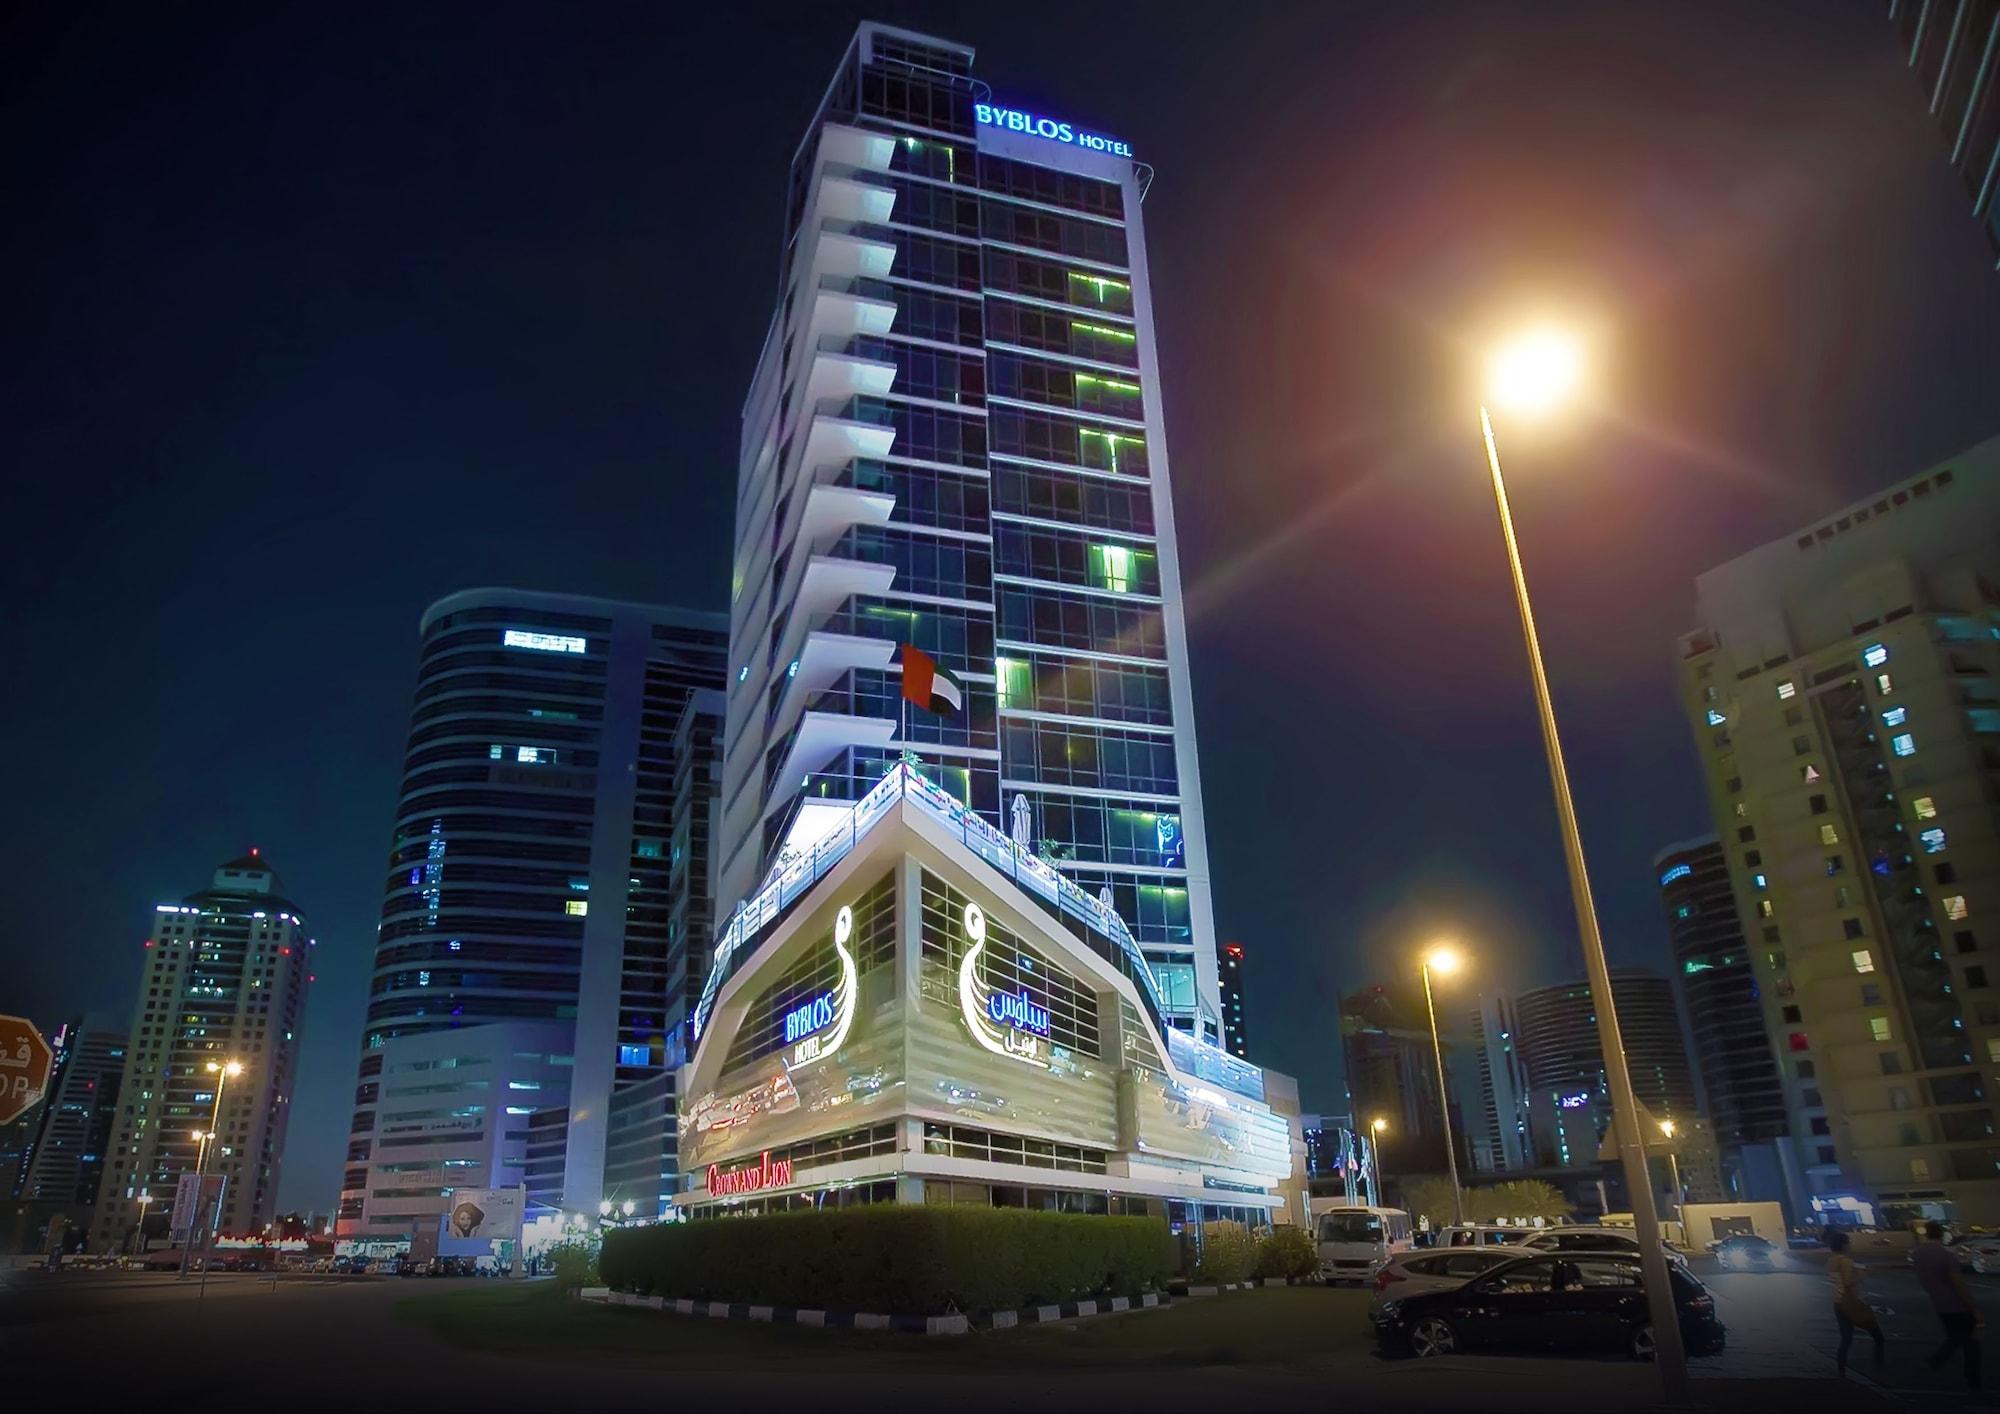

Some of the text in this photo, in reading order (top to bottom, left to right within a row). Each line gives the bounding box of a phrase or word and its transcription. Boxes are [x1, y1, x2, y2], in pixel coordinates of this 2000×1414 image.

[975, 104, 1133, 157] BYBLOS HOTEL
[786, 992, 832, 1042] BYBLOS
[991, 992, 1048, 1035] بيبلوس
[794, 1036, 821, 1064] HOTEL
[707, 1151, 791, 1197] CROWN AND LION
